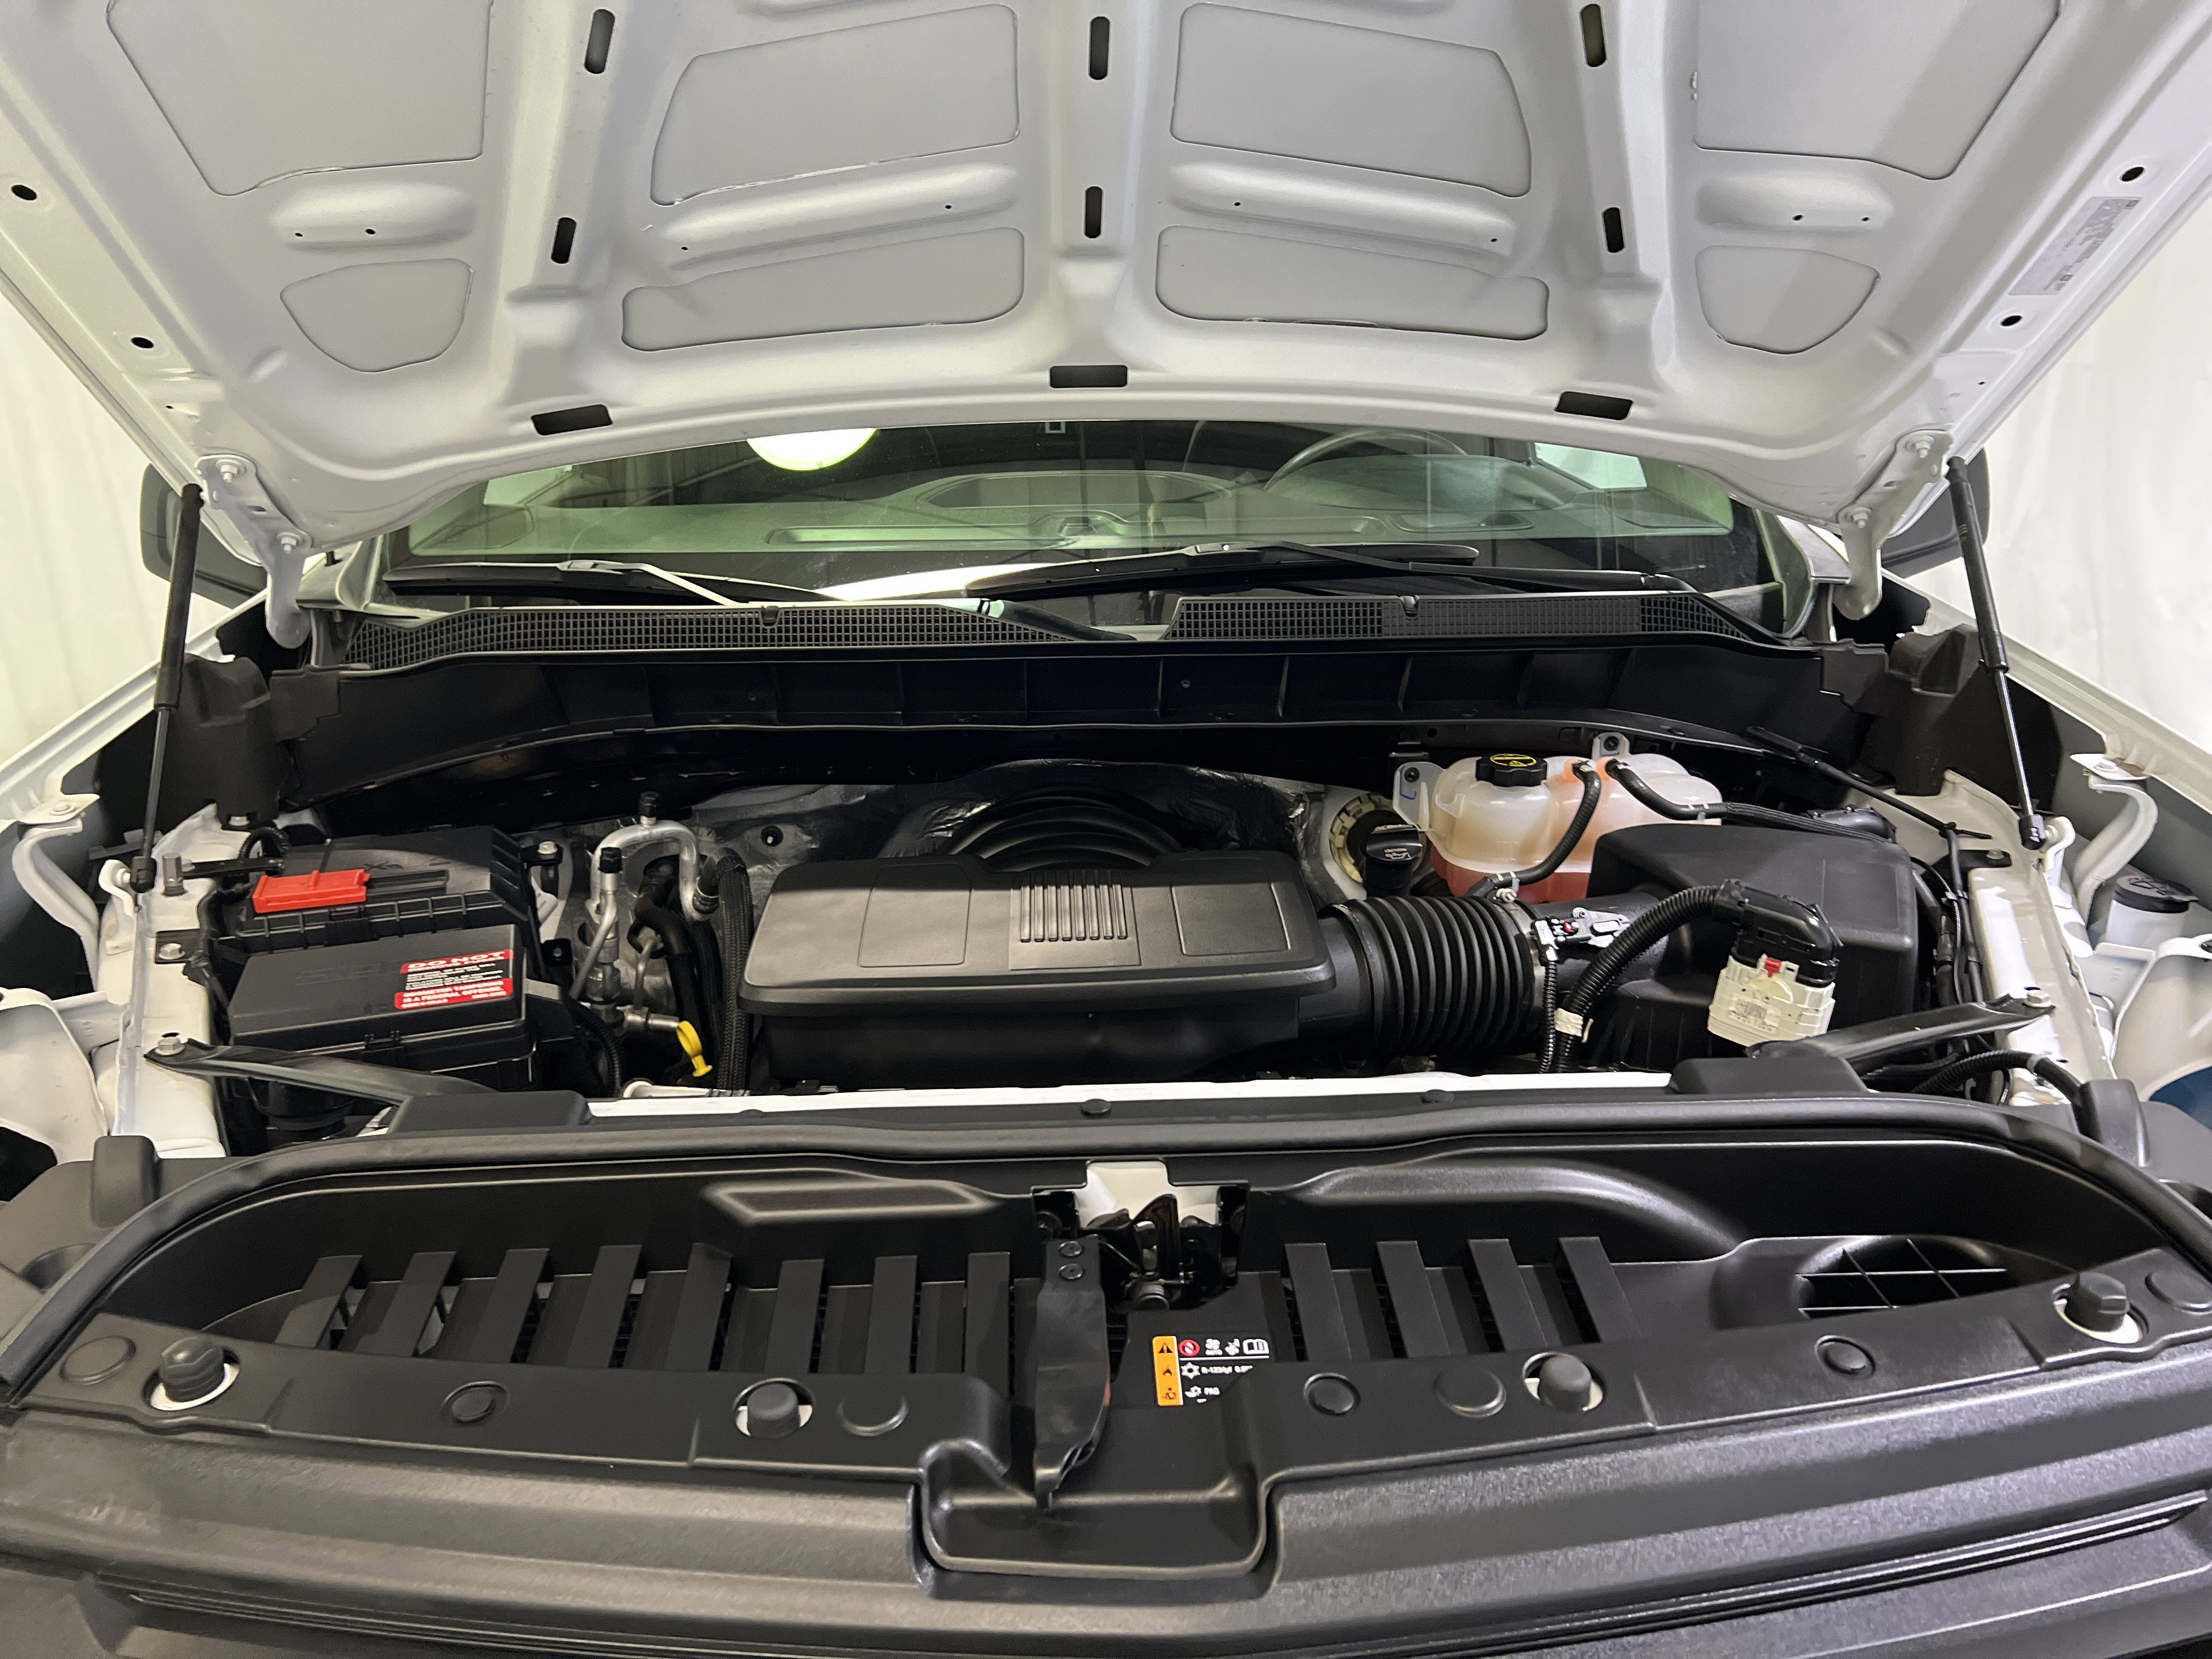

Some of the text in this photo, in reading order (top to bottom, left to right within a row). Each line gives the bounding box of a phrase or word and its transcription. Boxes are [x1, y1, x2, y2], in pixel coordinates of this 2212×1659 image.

[408, 951, 505, 968] DO NOT
[403, 980, 504, 998] ODOMETER TAMPERING
[421, 991, 461, 1001] FEDERAL
[1204, 1386, 1220, 1396] PAG
